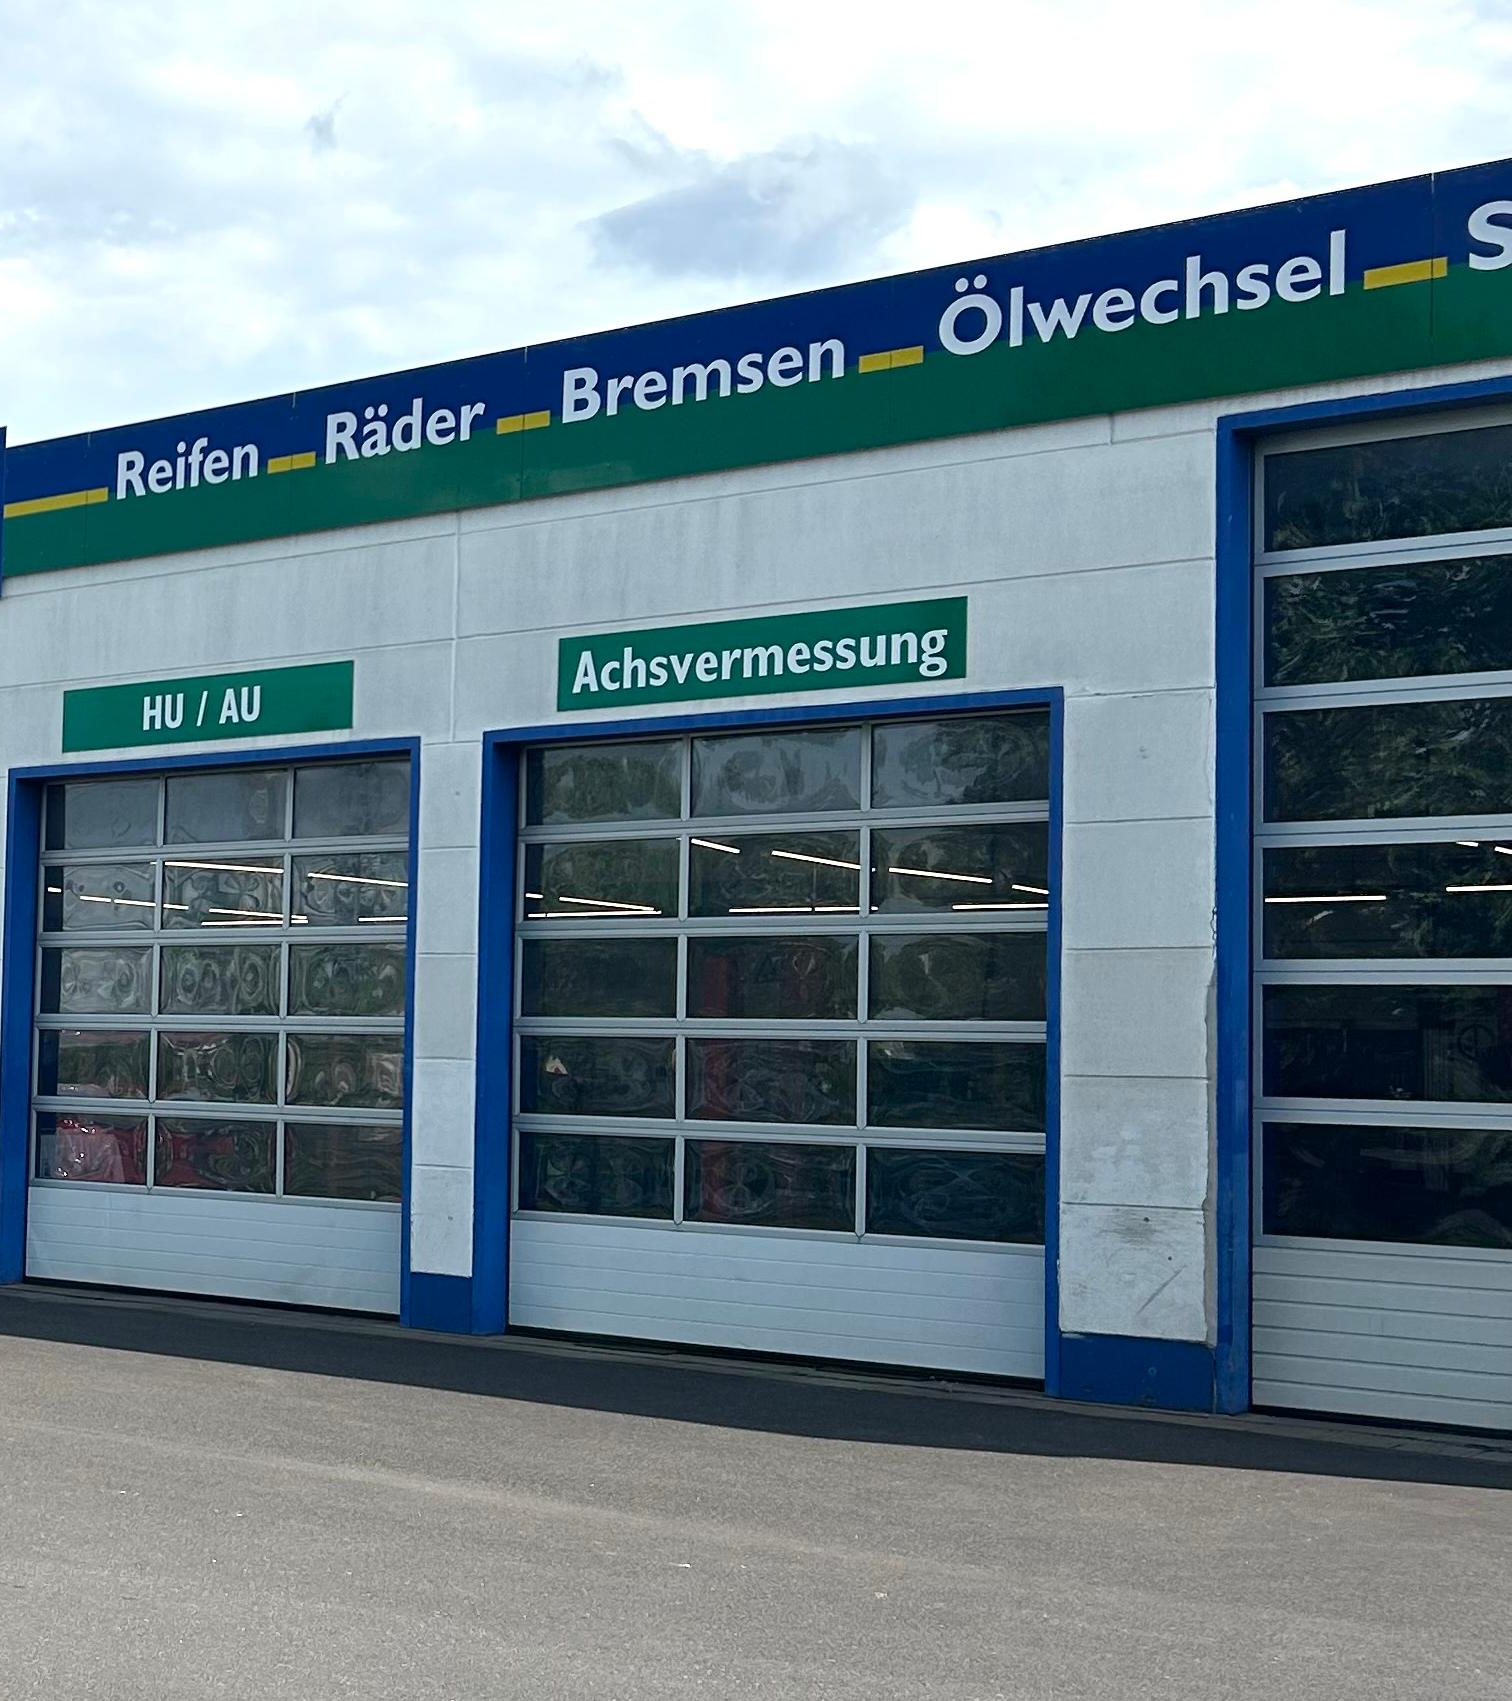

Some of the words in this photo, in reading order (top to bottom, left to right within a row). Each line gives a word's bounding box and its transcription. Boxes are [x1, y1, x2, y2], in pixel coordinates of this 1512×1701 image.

[116, 437, 259, 500] Reifen
[325, 397, 486, 465] Räder
[561, 337, 845, 424] Bremsen
[938, 229, 1347, 356] Ölwechsel
[571, 627, 949, 695] Achsvermessung
[142, 693, 184, 731] HU
[218, 685, 261, 724] AU
